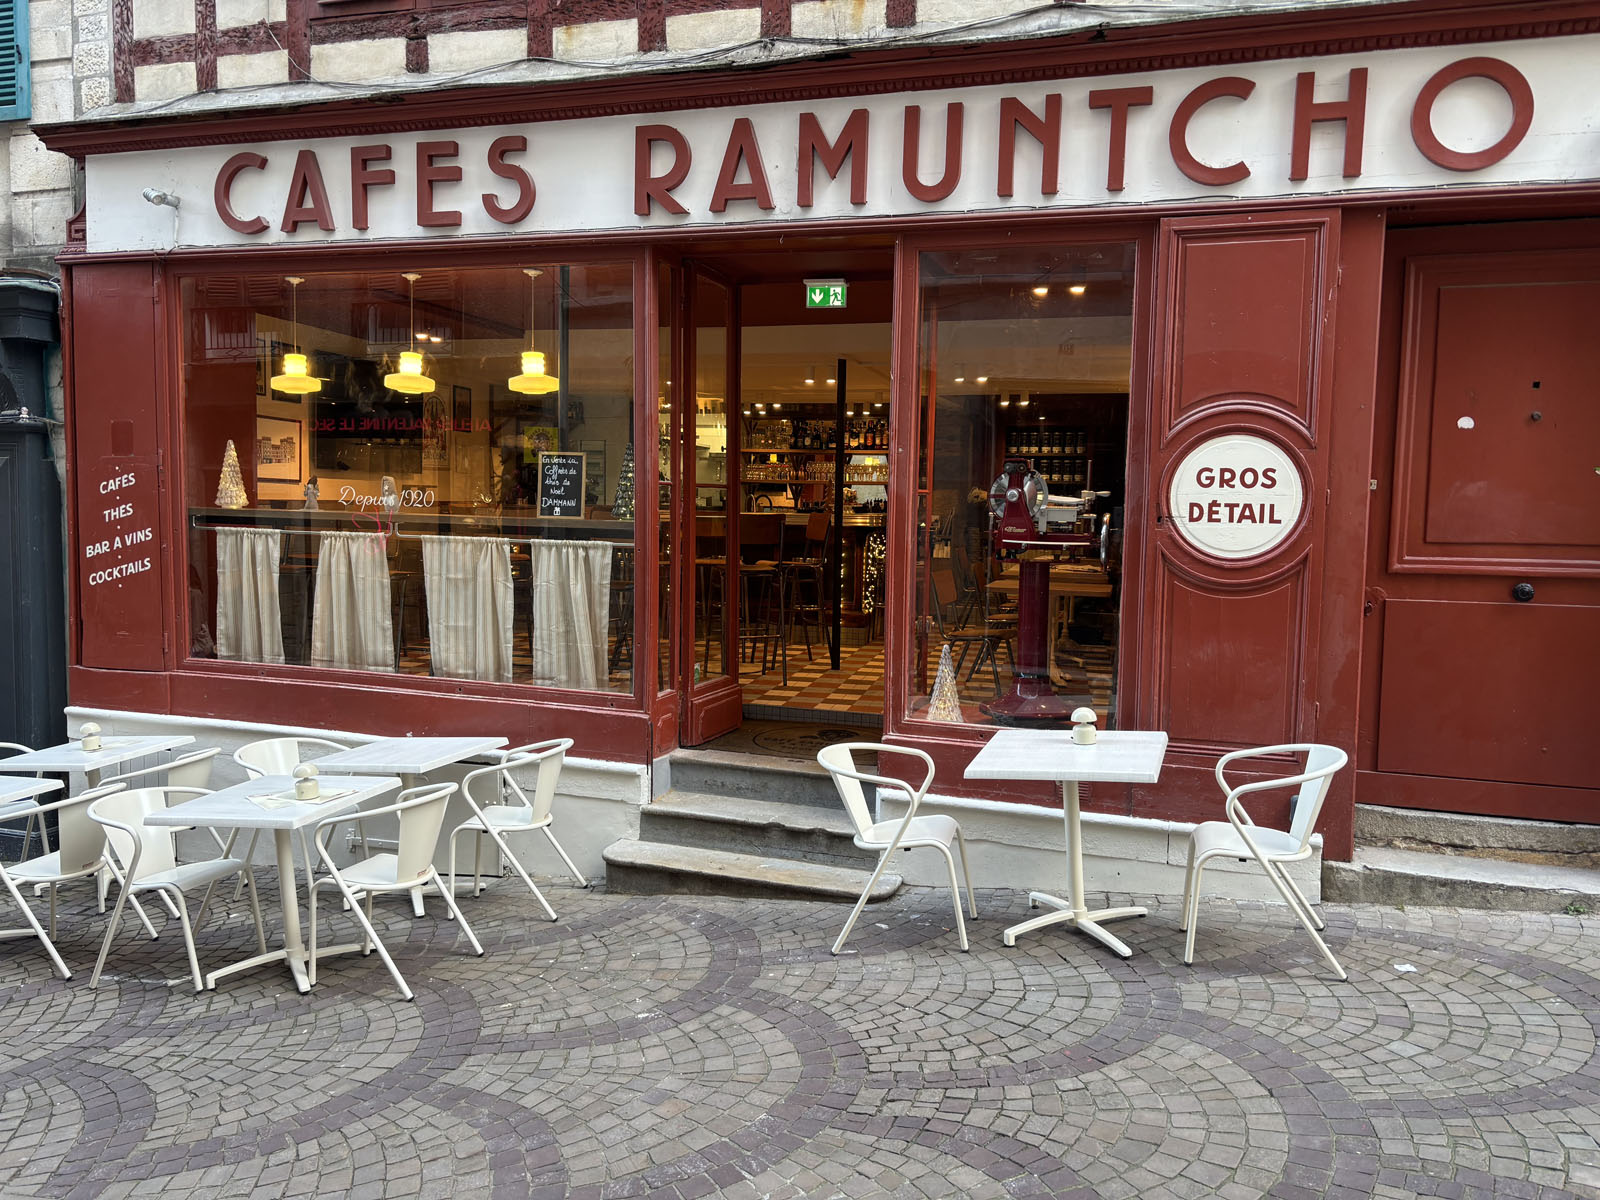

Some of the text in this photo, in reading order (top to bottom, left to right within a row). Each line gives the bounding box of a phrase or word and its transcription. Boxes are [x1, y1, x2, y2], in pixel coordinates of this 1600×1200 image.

[214, 56, 1536, 235] CAFES RAMUNTCHO
[100, 473, 136, 494] CAFES
[1196, 467, 1277, 489] GROS
[338, 485, 435, 512] Depuis 1920
[542, 497, 576, 507] DAMMANN
[104, 503, 133, 522] THES
[1188, 500, 1282, 524] DÉTAIL
[86, 528, 152, 558] BAR A VINS
[89, 558, 151, 585] COCKTAILS
